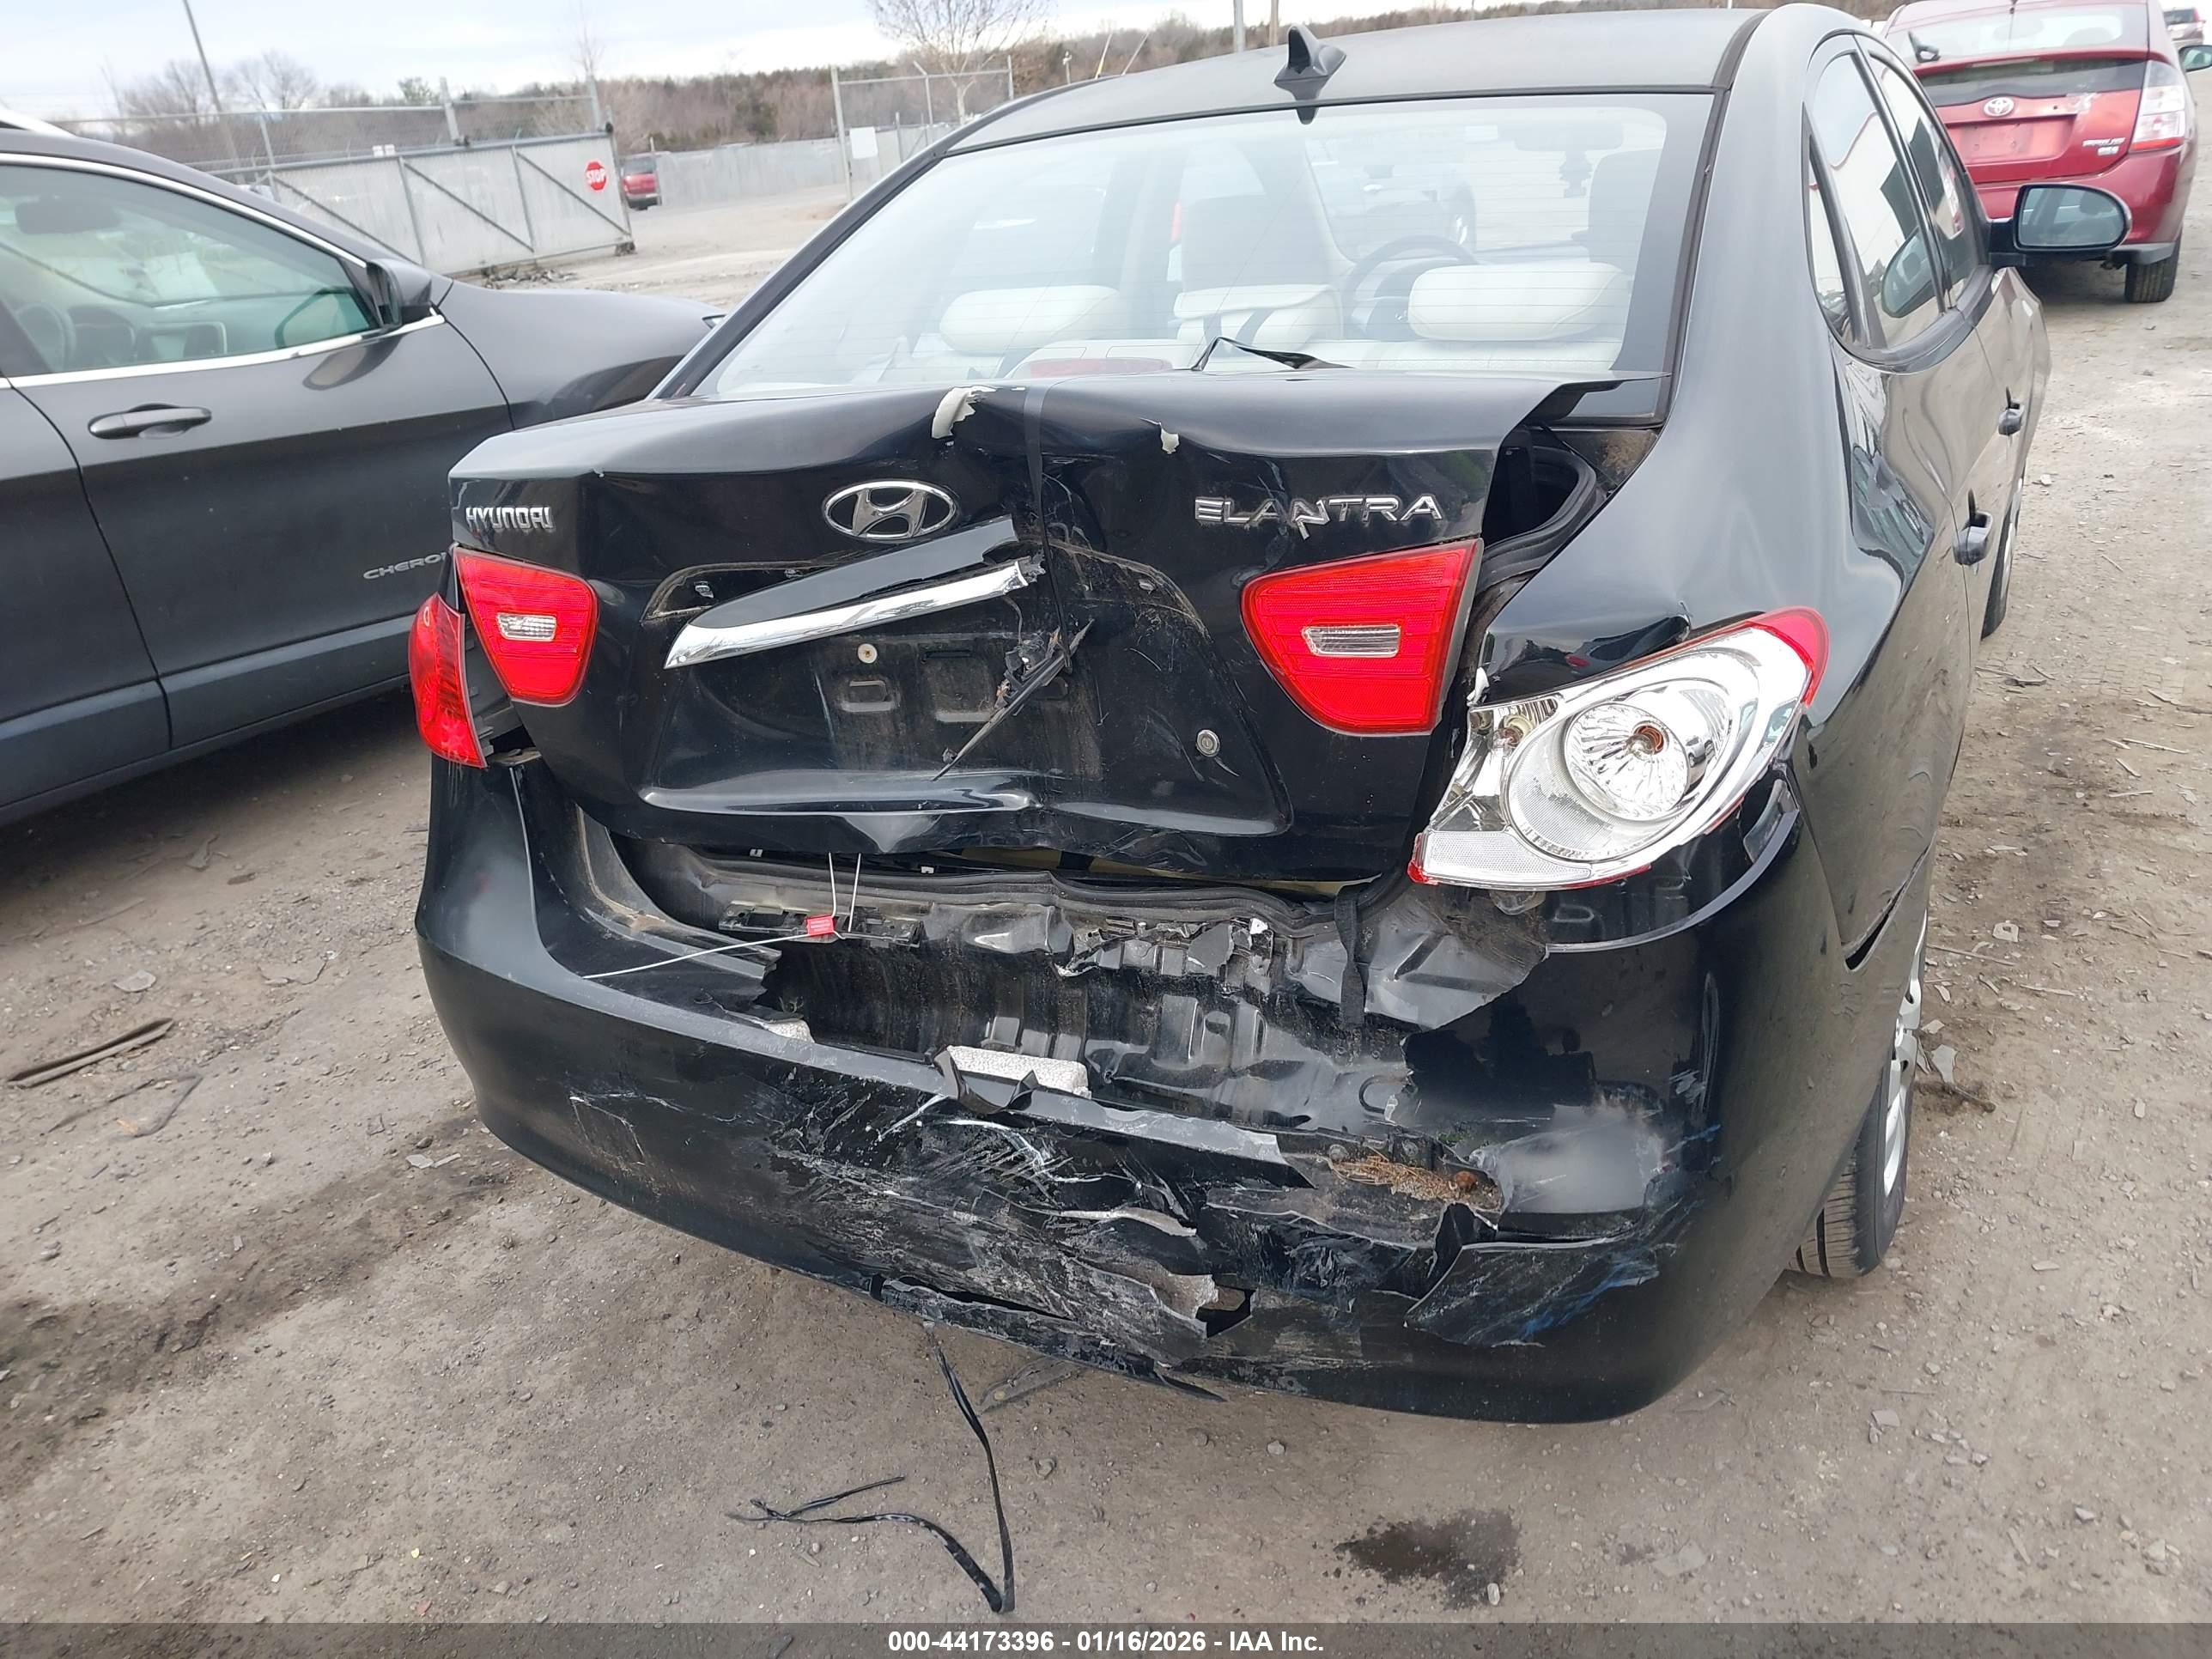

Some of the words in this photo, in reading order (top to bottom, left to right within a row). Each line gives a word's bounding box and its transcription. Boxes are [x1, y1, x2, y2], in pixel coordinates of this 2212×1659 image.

[586, 169, 605, 183] STOP
[465, 507, 554, 531] HYUNDAI
[1194, 495, 1443, 540] ELANTRA
